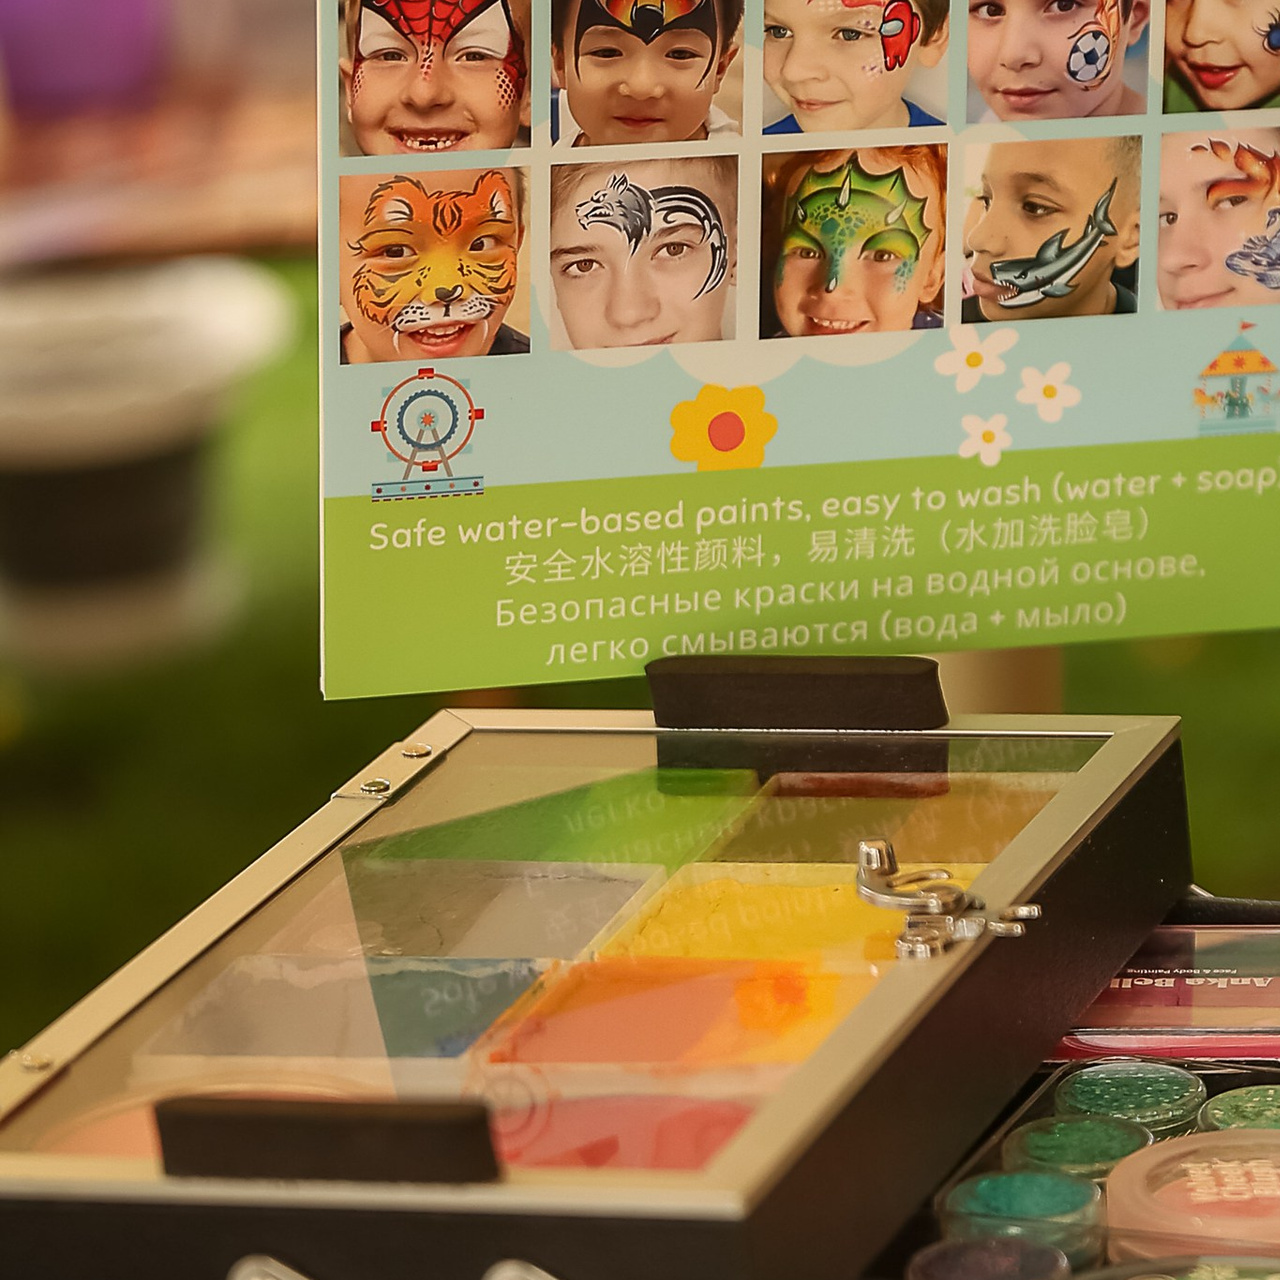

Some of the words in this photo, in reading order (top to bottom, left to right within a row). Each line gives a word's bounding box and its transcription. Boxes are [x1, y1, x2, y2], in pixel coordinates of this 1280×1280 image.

[369, 519, 446, 551] Safe
[458, 500, 685, 543] water-based
[695, 495, 811, 535] paints,
[821, 492, 900, 521] easy
[911, 486, 947, 512] to
[957, 476, 1041, 508] wash
[1052, 471, 1161, 504] (water
[1171, 473, 1188, 489] +
[496, 588, 722, 627] Безопасные
[734, 578, 859, 615] краски
[873, 574, 914, 599] на
[926, 558, 1060, 597] водной
[1070, 552, 1206, 584] основе.
[545, 634, 650, 666] легко
[661, 617, 869, 658] смываются
[879, 609, 978, 645] (вода
[989, 609, 1006, 627] +
[1016, 592, 1128, 630] мыло)
[1109, 977, 1176, 989] Bell
[1185, 977, 1274, 989] Anka
